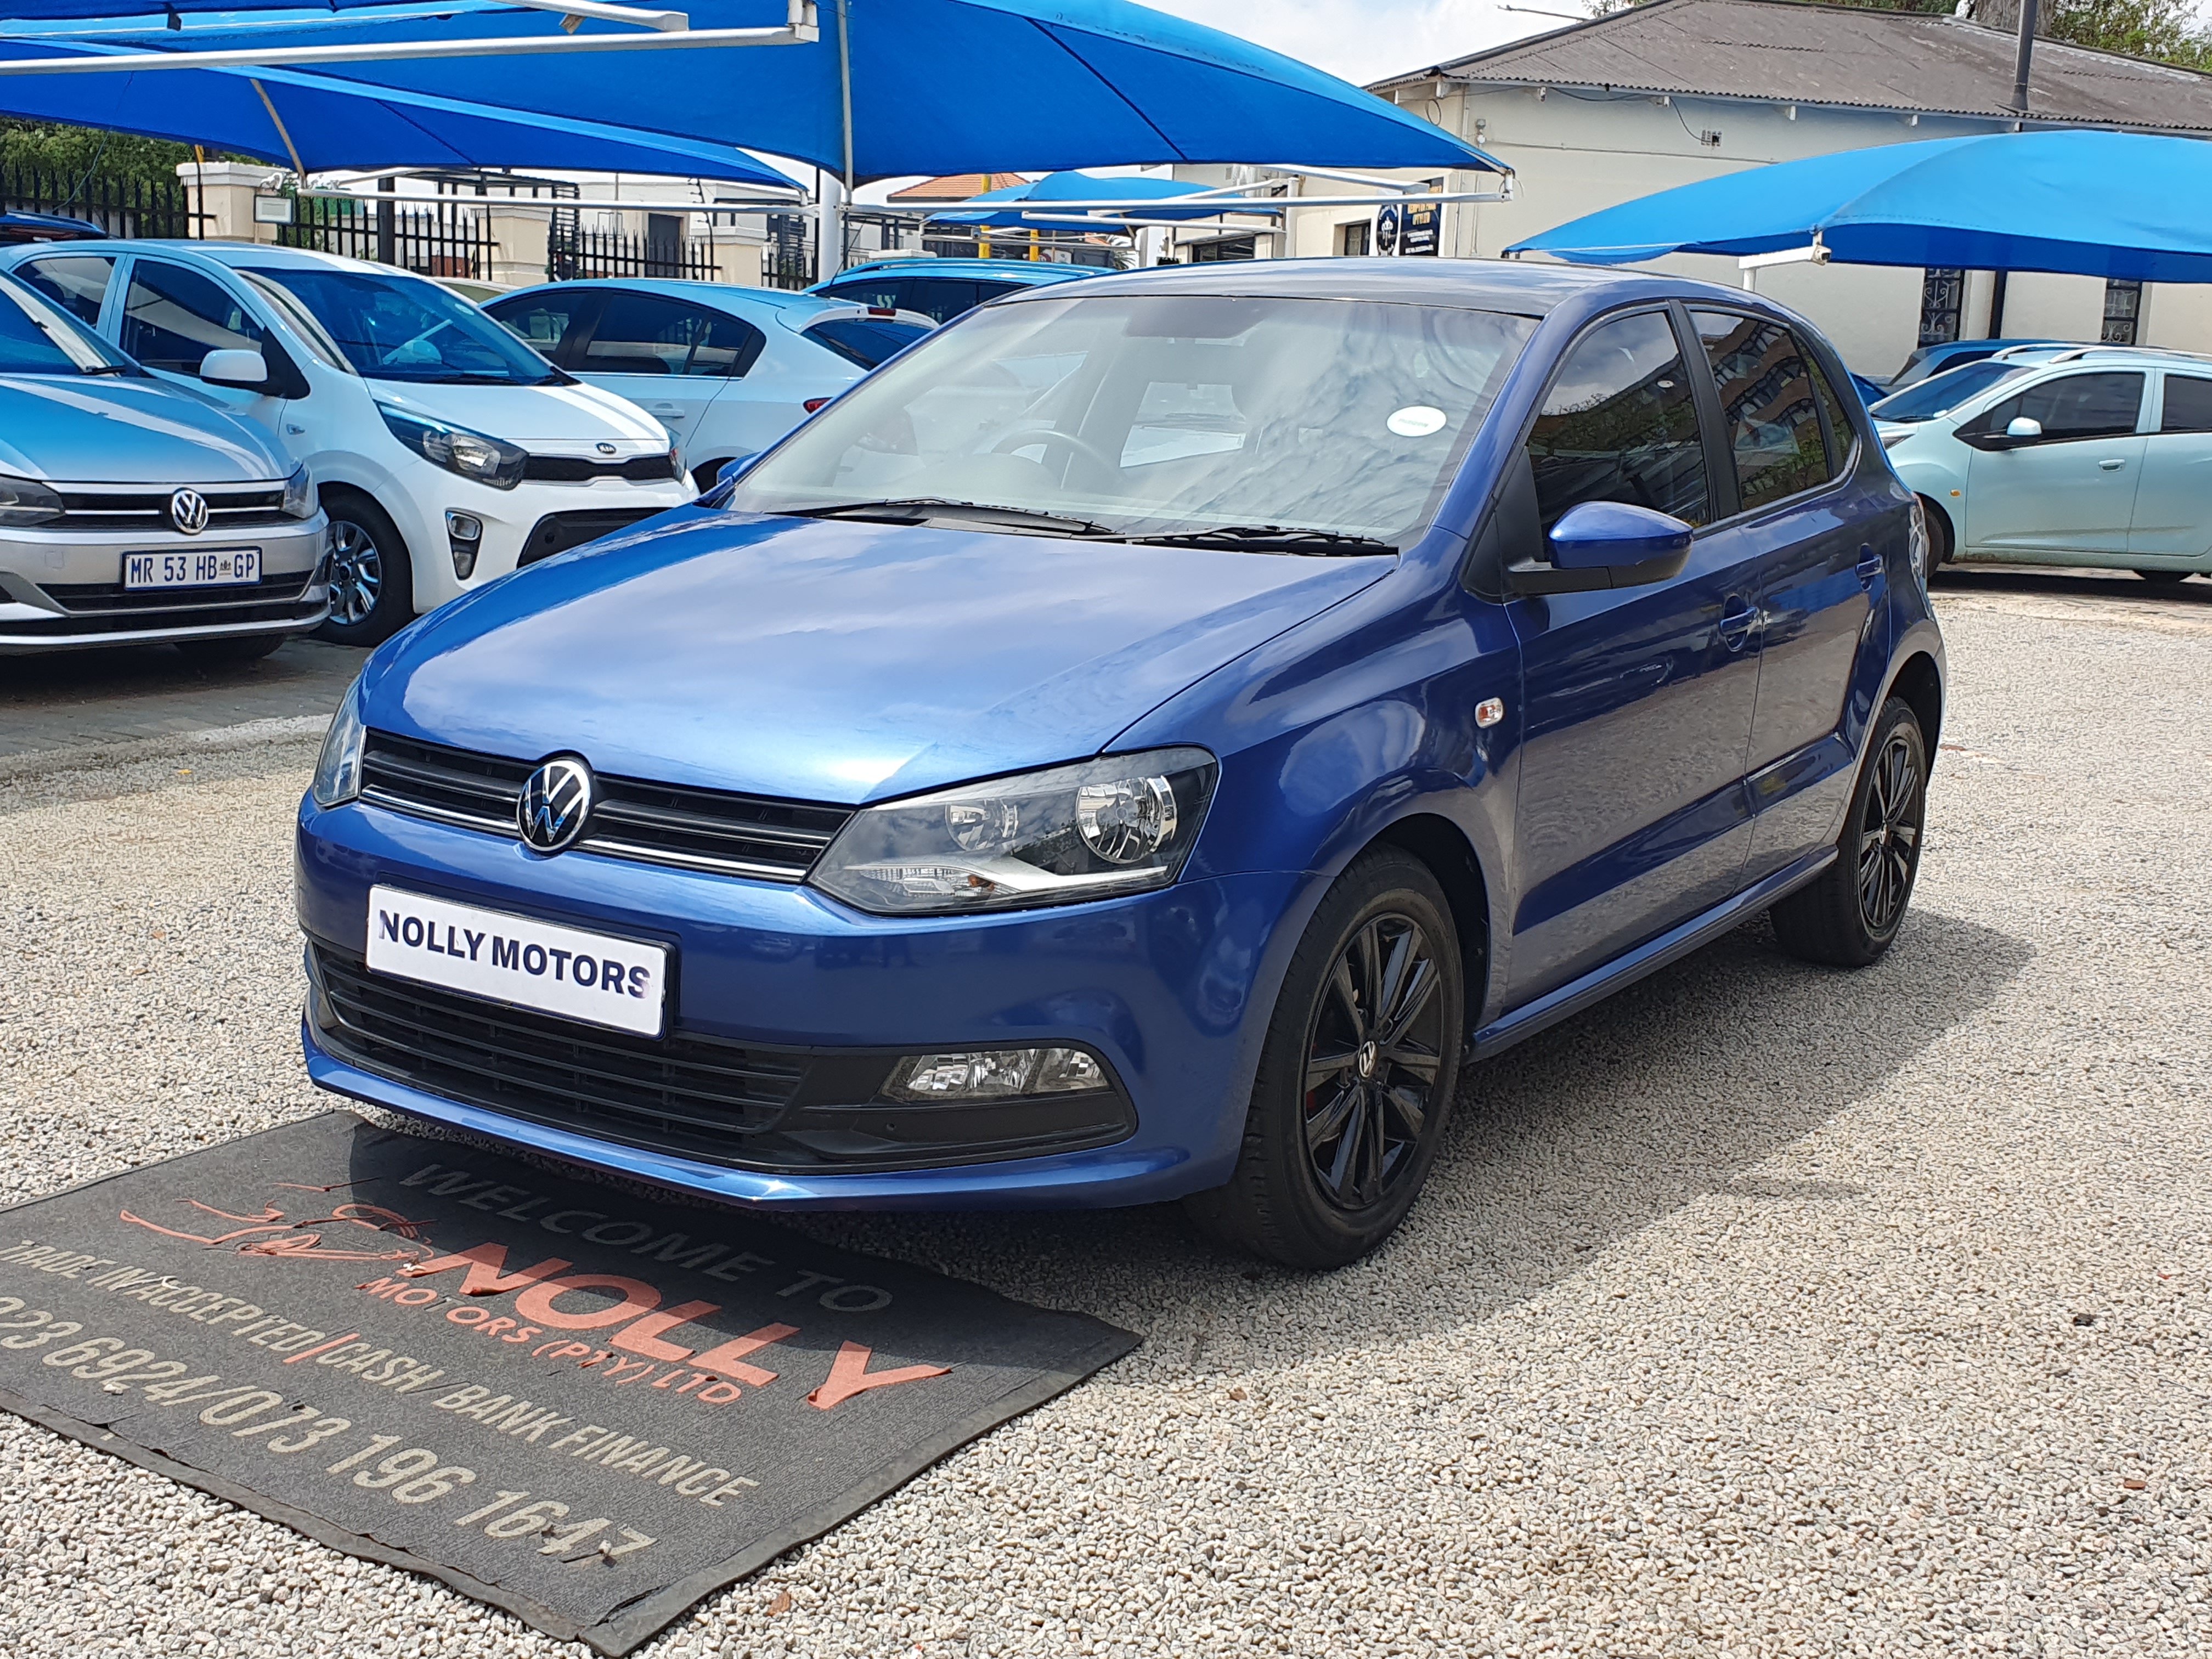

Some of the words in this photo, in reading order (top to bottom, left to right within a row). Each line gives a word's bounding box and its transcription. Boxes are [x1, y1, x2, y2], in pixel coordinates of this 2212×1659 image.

[131, 557, 154, 584] MR
[164, 556, 187, 582] 53
[195, 555, 217, 581] HB
[234, 553, 255, 578] GP
[378, 909, 486, 962] NOLLY
[492, 935, 651, 999] MOTORS
[400, 1164, 776, 1282] WELCOME
[777, 1269, 893, 1312] TO
[0, 1239, 119, 1279] TRADE
[548, 1424, 761, 1506] FINANCE
[396, 1242, 952, 1409] NOLLY
[326, 1433, 476, 1504] 196
